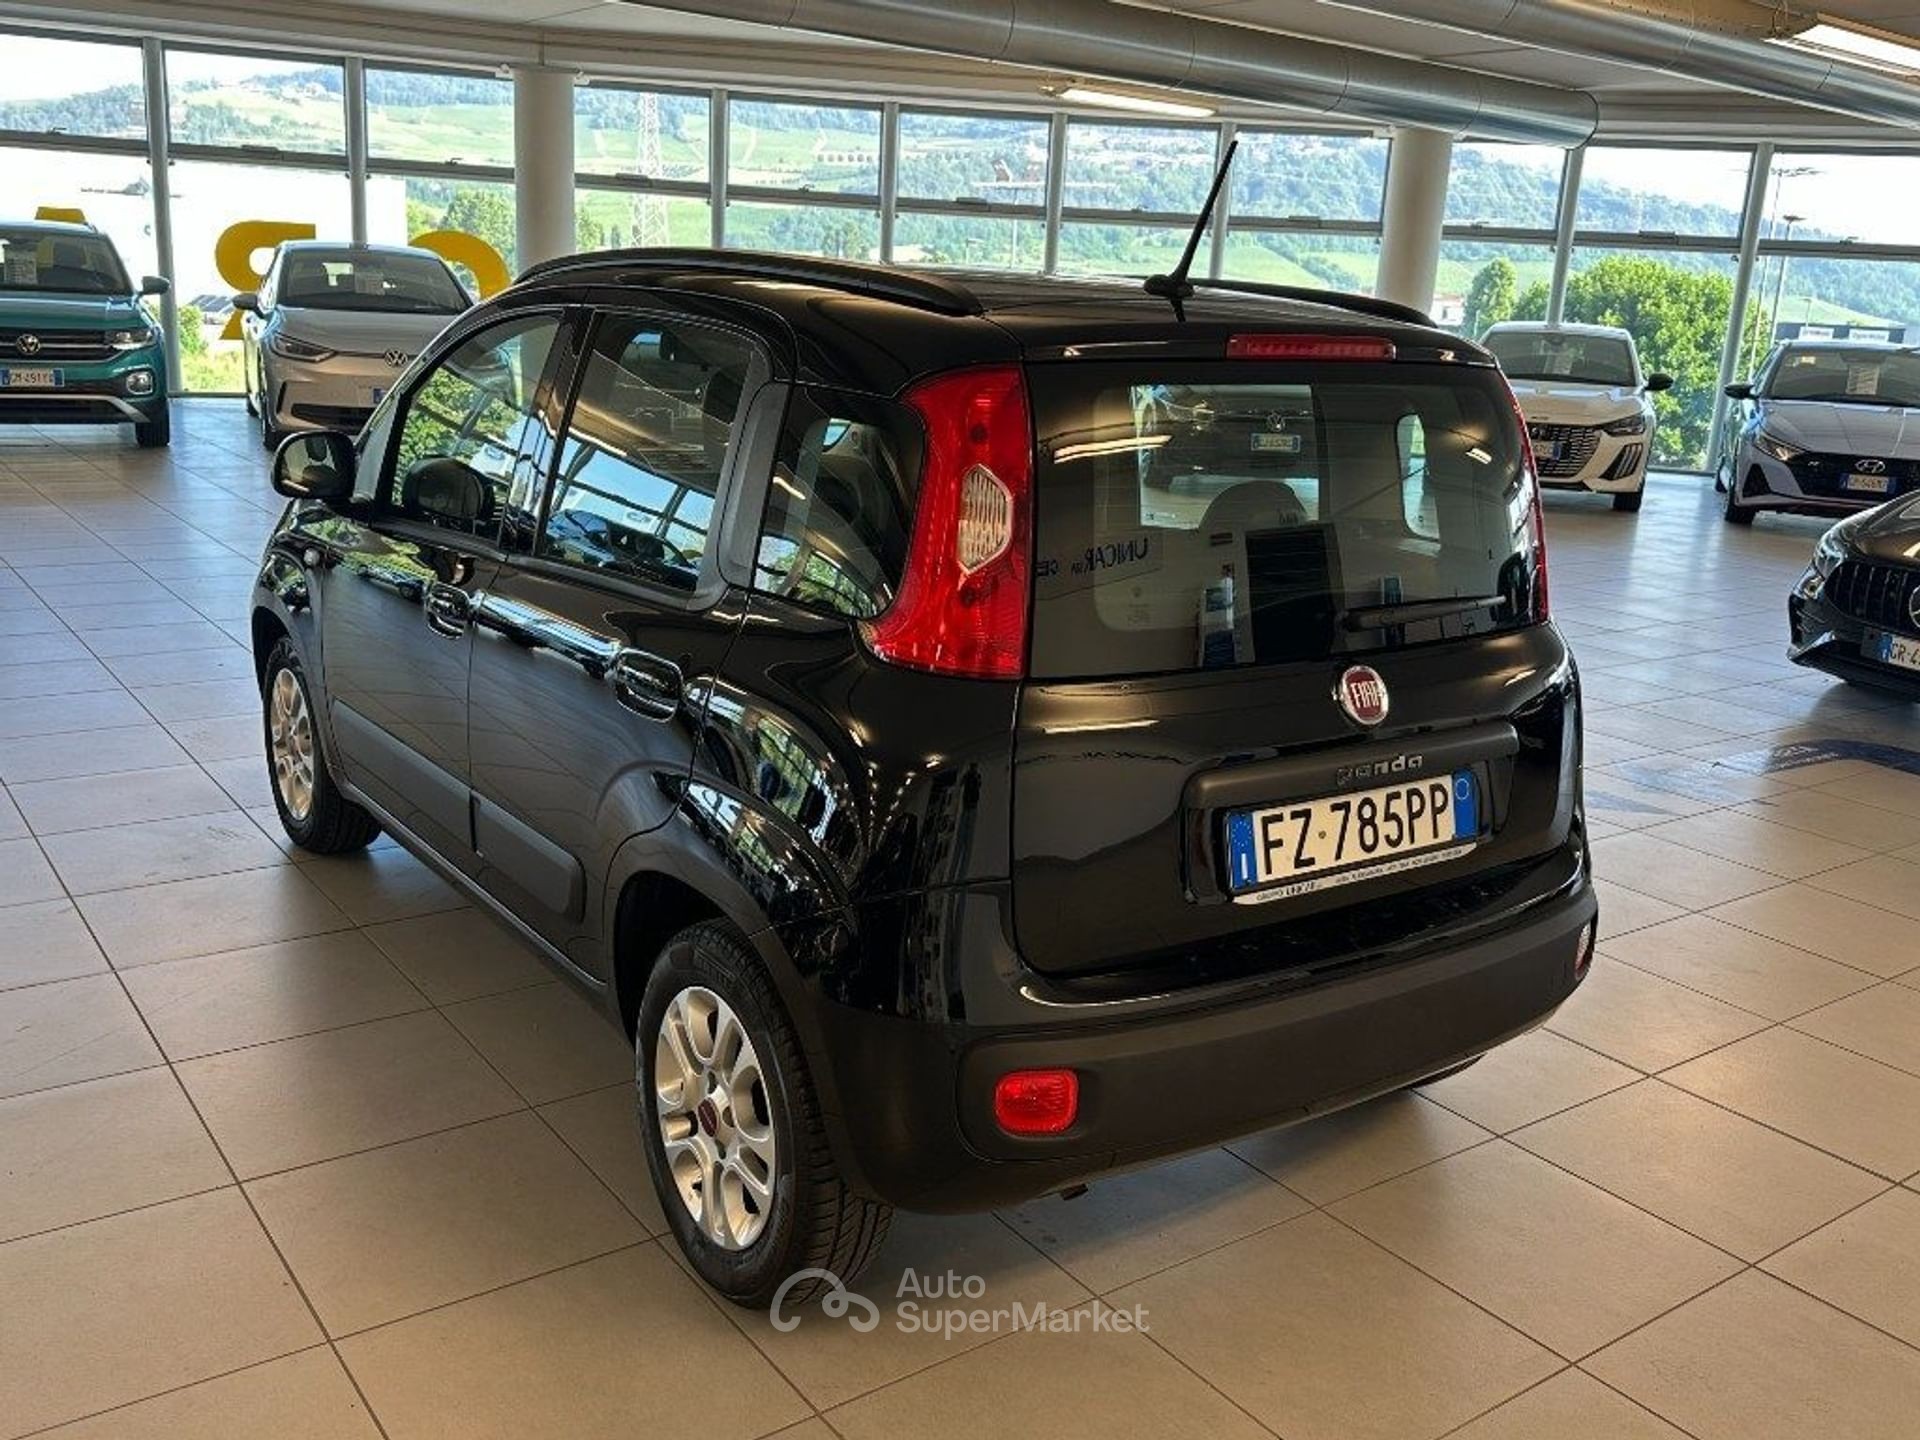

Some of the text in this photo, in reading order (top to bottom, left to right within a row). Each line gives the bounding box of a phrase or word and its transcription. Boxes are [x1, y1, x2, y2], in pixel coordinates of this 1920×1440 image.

[1350, 681, 1381, 708] FIAT
[1337, 753, 1423, 786] panda
[1260, 808, 1316, 875] FZ
[1329, 783, 1449, 861] 785PP
